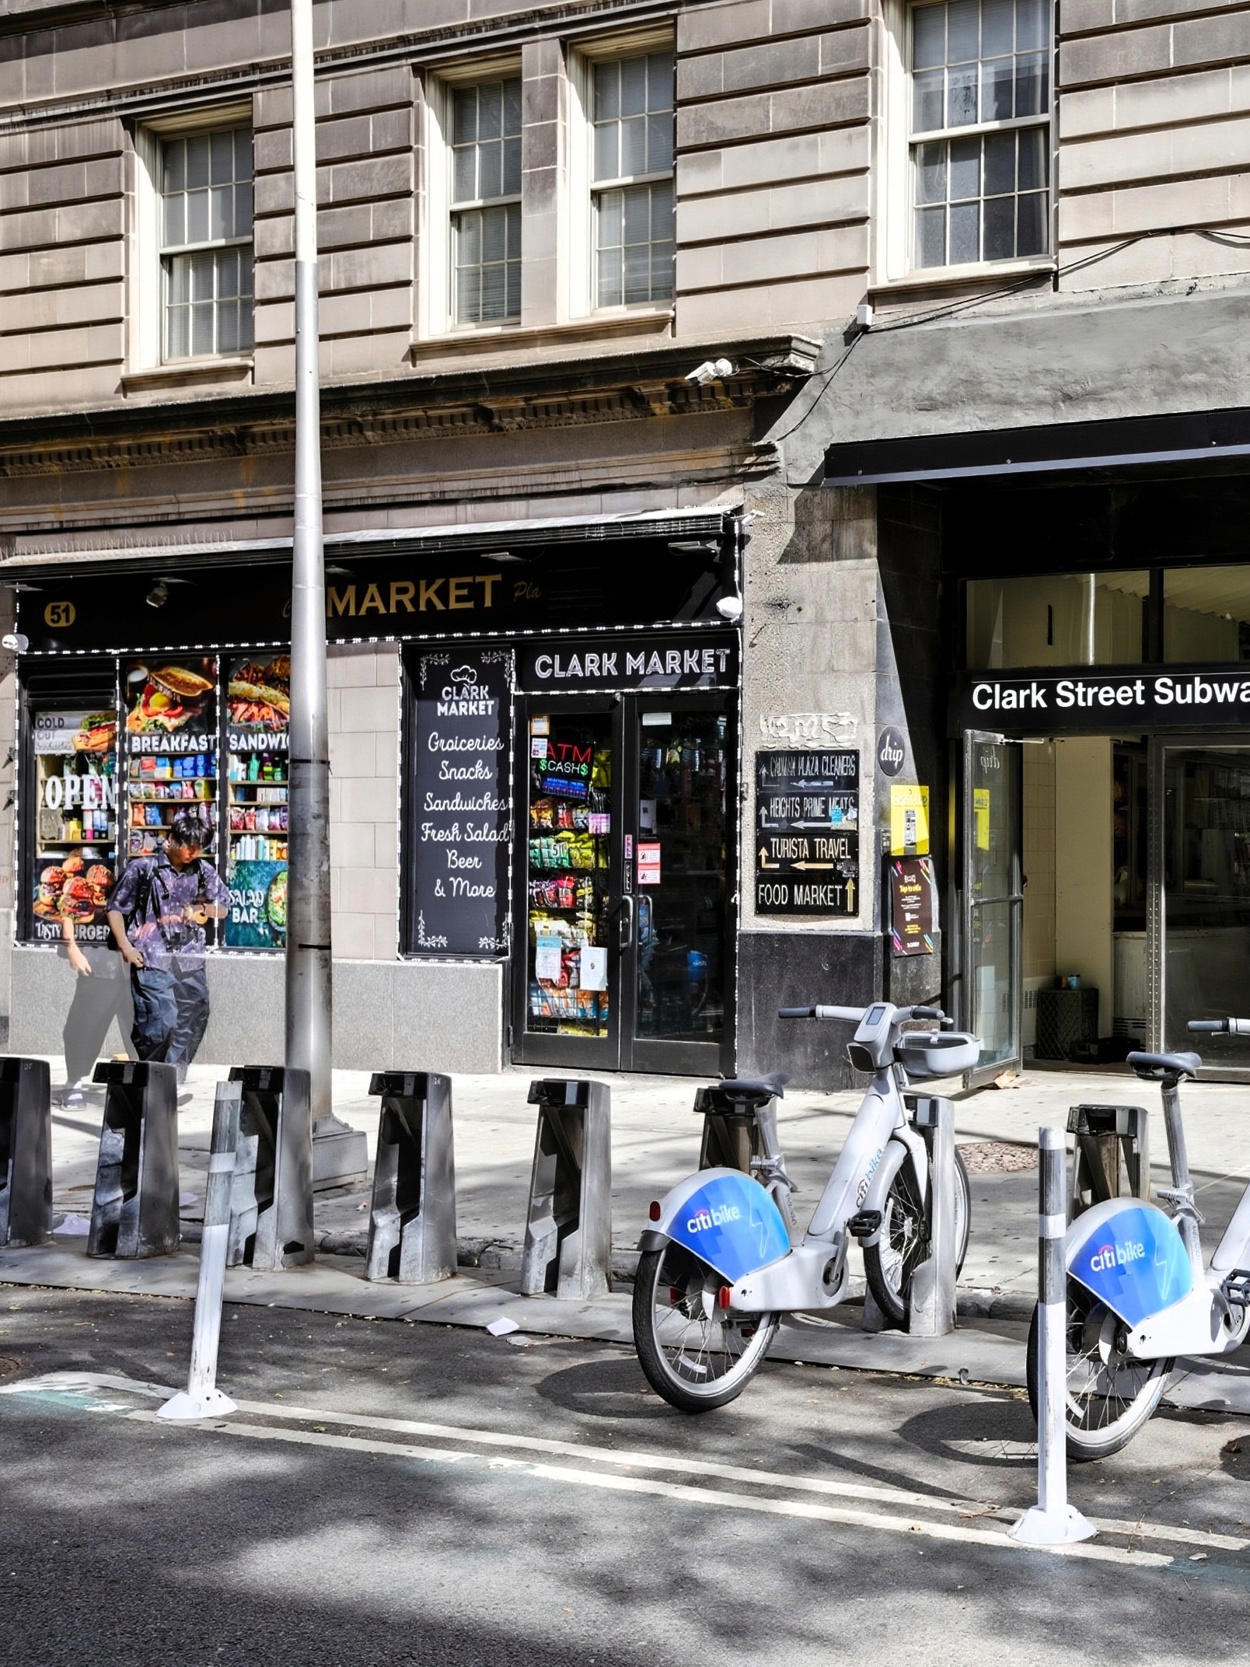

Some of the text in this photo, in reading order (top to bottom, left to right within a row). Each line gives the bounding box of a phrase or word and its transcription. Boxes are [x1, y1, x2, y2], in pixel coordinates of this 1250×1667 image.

[327, 574, 502, 617] MARKET
[49, 604, 72, 624] 51
[535, 648, 730, 678] CLARK MARKET
[441, 684, 490, 701] CLARK
[972, 681, 1047, 711] Clark
[1055, 679, 1145, 708] Street
[436, 700, 495, 717] MARKET
[36, 717, 65, 729] COLD
[131, 735, 216, 753] BREAKFAST
[229, 733, 290, 751] SANDWI
[546, 742, 592, 763] ATM
[880, 734, 903, 768] drip
[438, 759, 493, 780] Snacks
[798, 755, 819, 776] PLAZA
[822, 755, 856, 777] CLEANERS
[45, 774, 116, 811] OPEN
[423, 791, 508, 811] Sandwiches
[769, 797, 801, 818] HEIGHTS
[803, 797, 826, 817] PRIME
[421, 822, 509, 842] Fresh Salad
[446, 849, 482, 869] Beer
[770, 838, 852, 859] TURISTA TRAVEL
[434, 877, 496, 898] & More
[758, 884, 843, 906] FOOD MARKET
[232, 907, 258, 924] BAR
[72, 924, 110, 941] URGER
[687, 1205, 741, 1233] citi bike
[1090, 1240, 1145, 1272] citi bike
